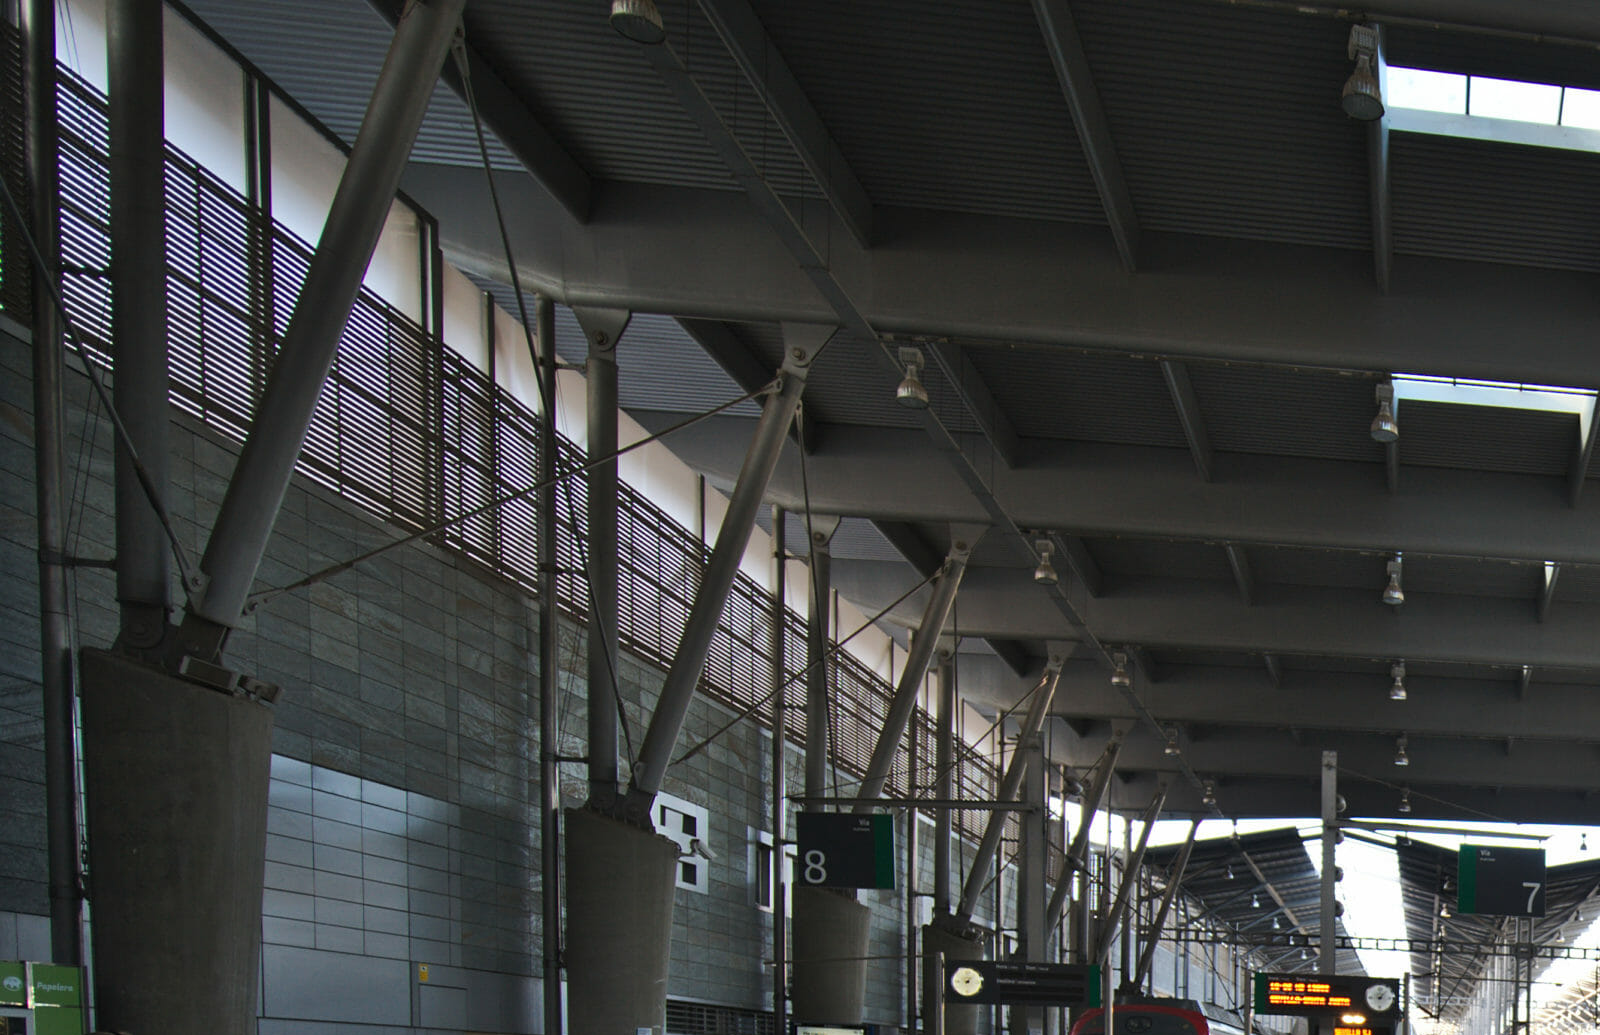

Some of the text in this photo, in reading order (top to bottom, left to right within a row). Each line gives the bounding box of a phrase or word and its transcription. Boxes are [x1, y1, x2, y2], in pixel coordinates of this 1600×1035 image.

[804, 849, 827, 884] 8
[1522, 881, 1541, 913] 7
[36, 980, 73, 993] Papelera
